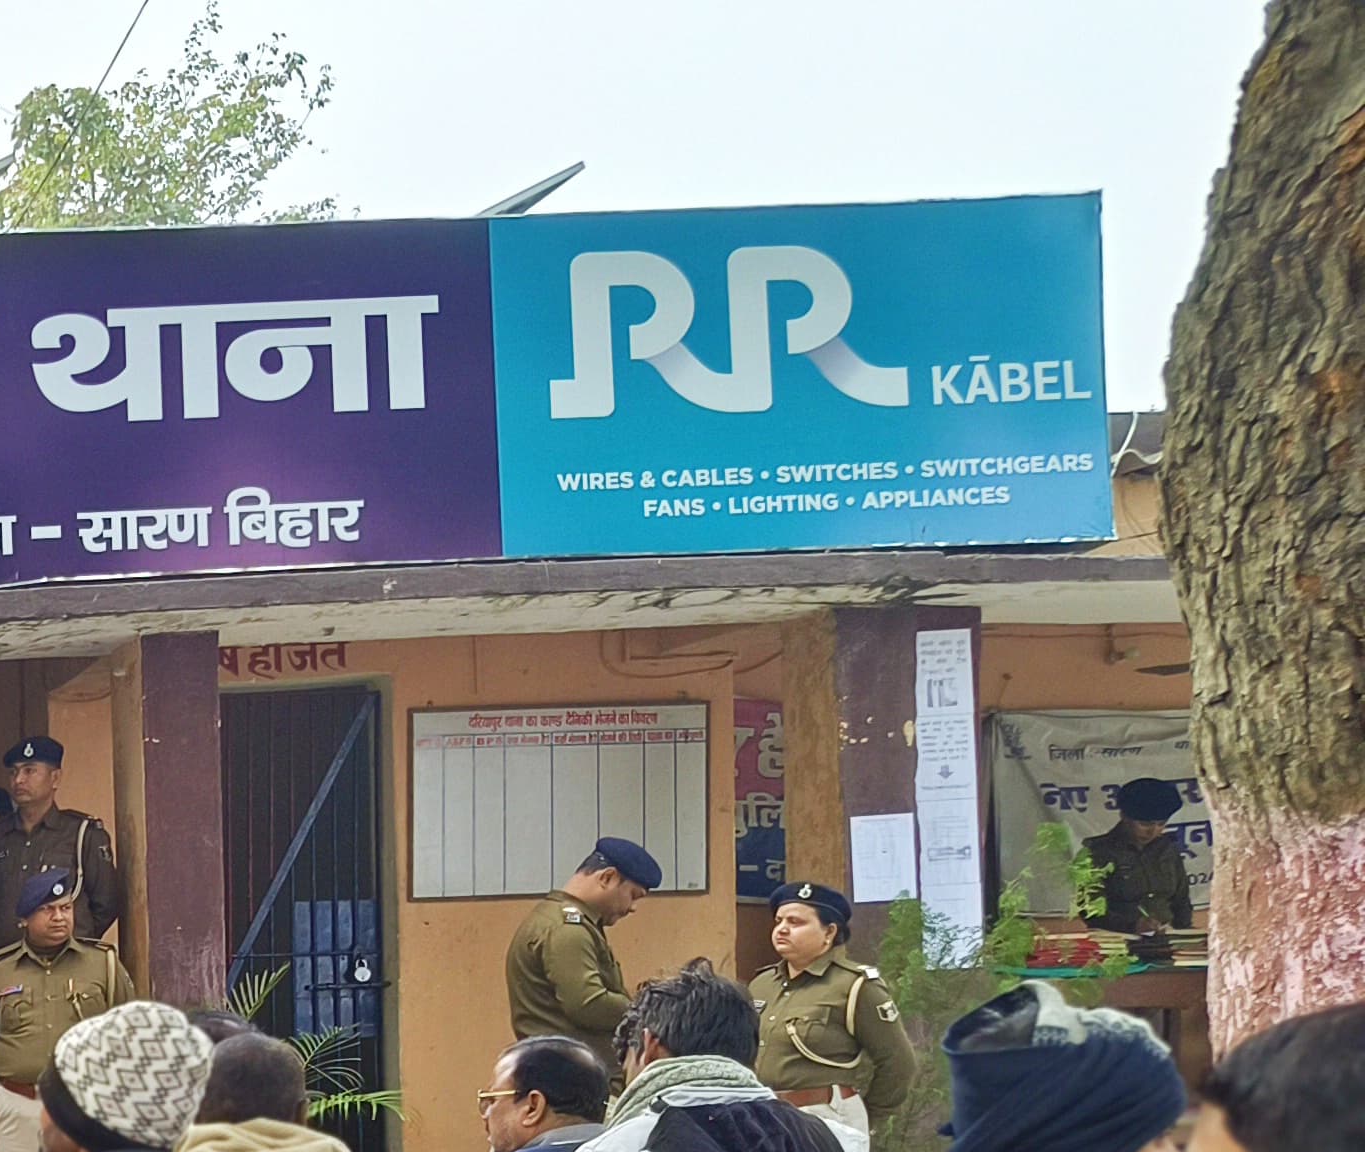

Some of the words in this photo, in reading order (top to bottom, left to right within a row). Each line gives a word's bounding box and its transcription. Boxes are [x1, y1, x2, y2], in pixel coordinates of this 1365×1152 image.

[550, 246, 909, 419] RR
[31, 295, 438, 422] थाना
[931, 355, 1092, 405] KĀBEL
[557, 471, 633, 491] WIRES
[640, 473, 656, 488] &
[661, 467, 754, 488] CABLES
[776, 462, 898, 485] SWITCHES
[920, 454, 1094, 478] SWITCHGEARS
[78, 507, 213, 552] सारण
[224, 487, 364, 548] बिहार
[643, 498, 705, 518] FANS
[728, 492, 839, 515] LIGHTING
[862, 487, 1010, 510] APPLIANCES
[1048, 743, 1085, 761] जिला
